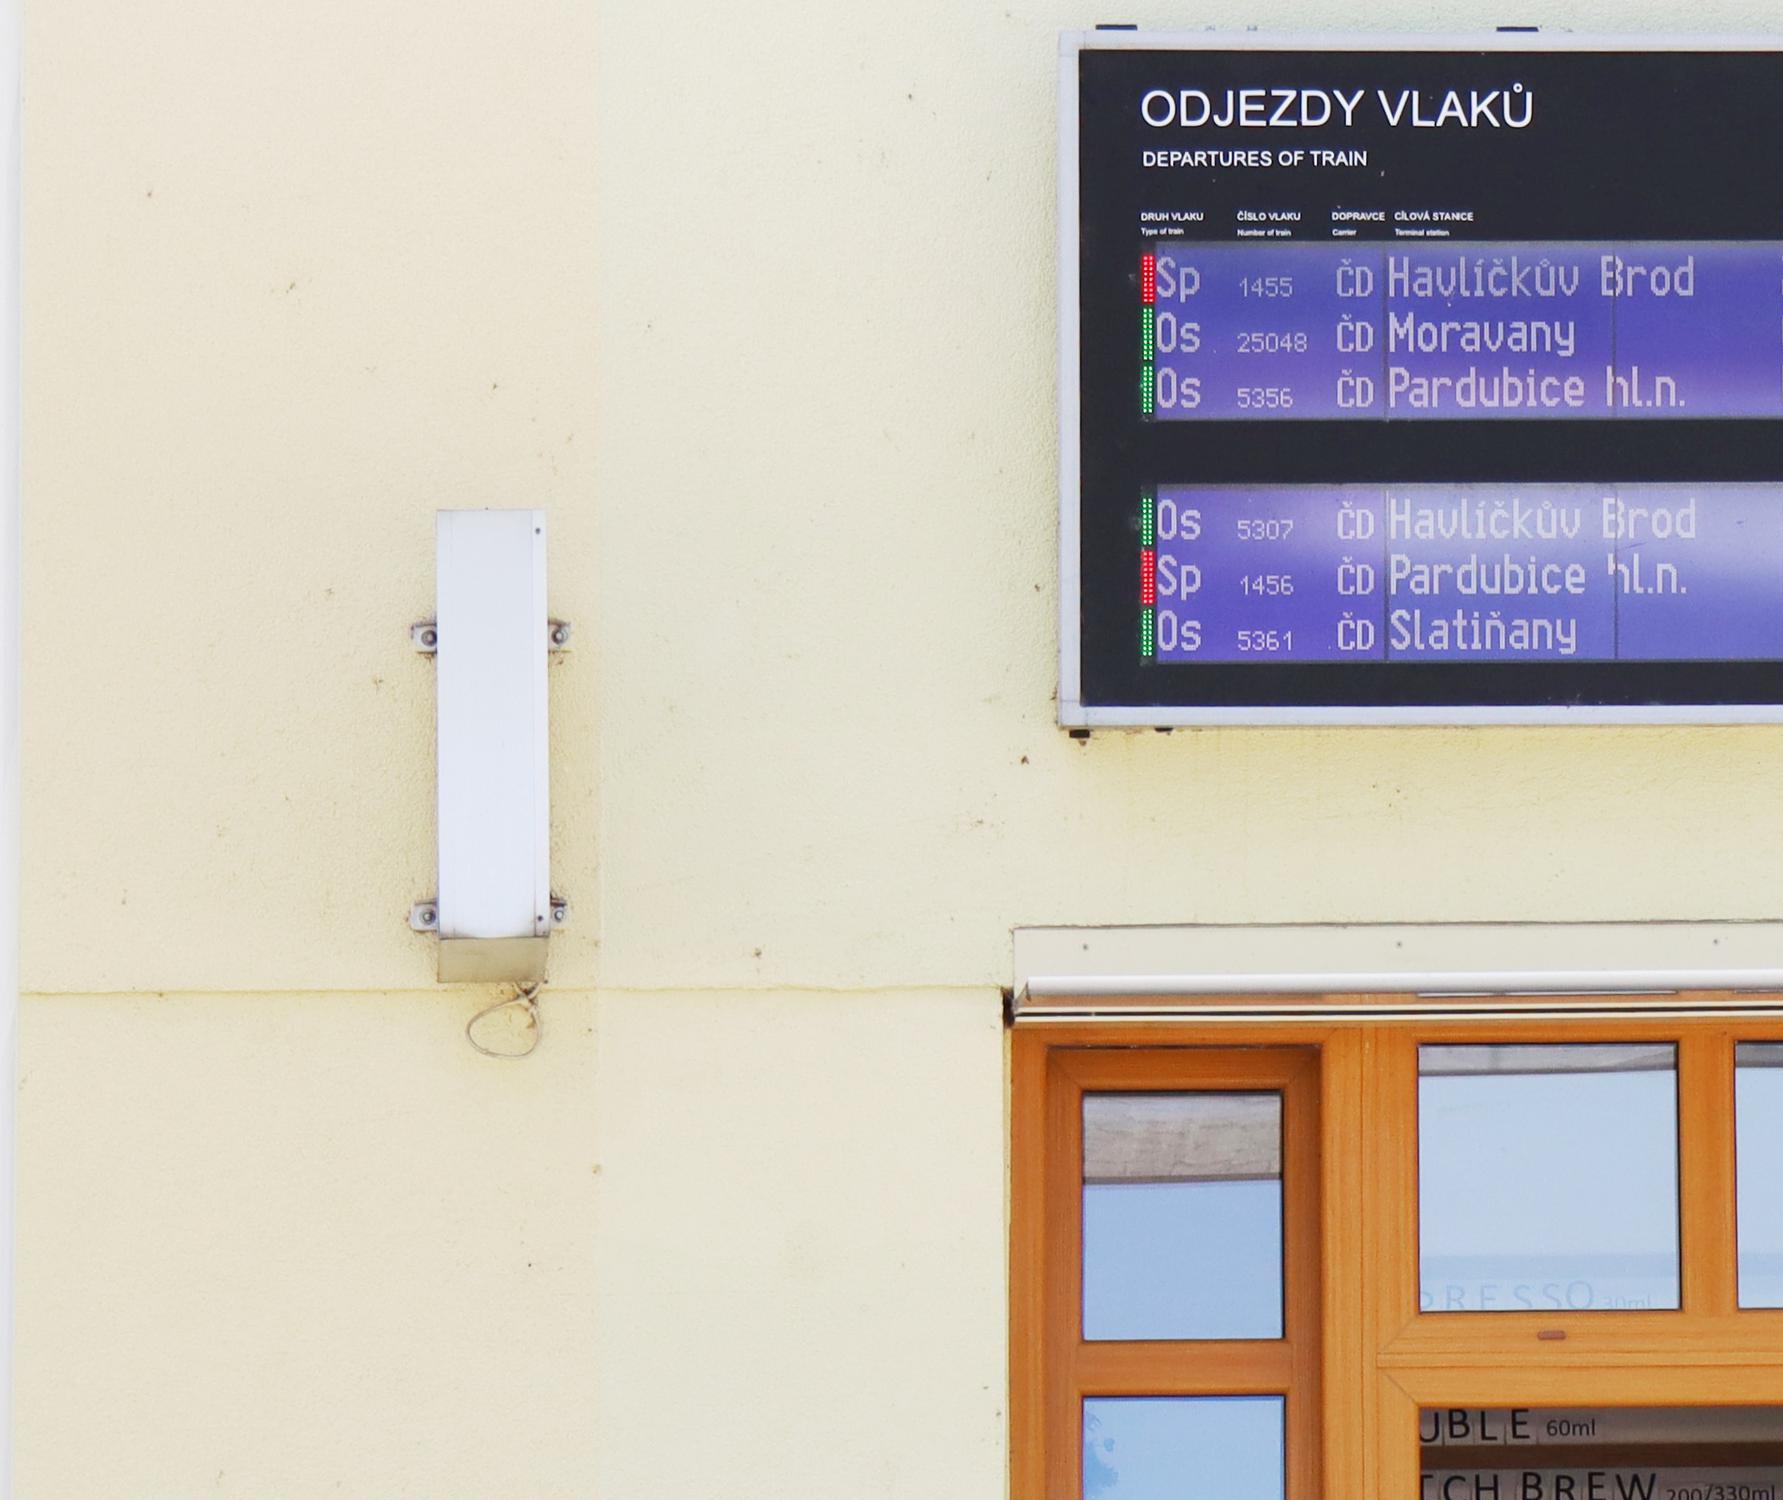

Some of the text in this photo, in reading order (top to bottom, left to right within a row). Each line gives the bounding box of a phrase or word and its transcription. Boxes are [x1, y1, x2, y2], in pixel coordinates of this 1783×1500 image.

[1141, 82, 1534, 128] ODJEZDY VLAKŮ
[1142, 150, 1368, 168] DEPARTURES OF TRAIN
[1140, 212, 1204, 222] DRUH VLAKU
[1236, 210, 1301, 222] ČÍSLO VLAKU
[1331, 212, 1386, 222] DOPRAVCE
[1394, 210, 1431, 222] CÍLOVÁ
[1140, 227, 1158, 237] Type
[1168, 227, 1185, 236] train
[1155, 255, 1200, 303] Sp
[1238, 276, 1294, 299] 1455
[1336, 258, 1374, 298] ČD
[1388, 255, 1580, 298] Havlíčkův
[1600, 255, 1696, 298] Brod
[1155, 311, 1200, 354] Os
[1237, 332, 1308, 354] 25048
[1336, 314, 1374, 353] ČD
[1388, 312, 1576, 357] Moravany
[1155, 367, 1200, 410] Os
[1237, 387, 1293, 409] 5356
[1336, 369, 1374, 409] ČD
[1388, 367, 1585, 409] Pardubice
[1604, 367, 1687, 409] hl.n.
[1156, 499, 1201, 541] Os
[1237, 519, 1294, 541] 5307
[1337, 501, 1375, 541] ČD
[1389, 498, 1582, 541] Havlíčkův
[1602, 498, 1697, 541] Brod
[1156, 553, 1201, 600] Sp
[1238, 574, 1294, 597] 1456
[1337, 557, 1375, 596] ČD
[1389, 554, 1586, 596] Pardubice
[1606, 555, 1689, 596] hl.n.
[1156, 609, 1201, 652] Os
[1237, 630, 1293, 652] 5361
[1337, 612, 1375, 652] ČD
[1389, 609, 1577, 656] Slatiňany
[1546, 1418, 1597, 1438] 60ml
